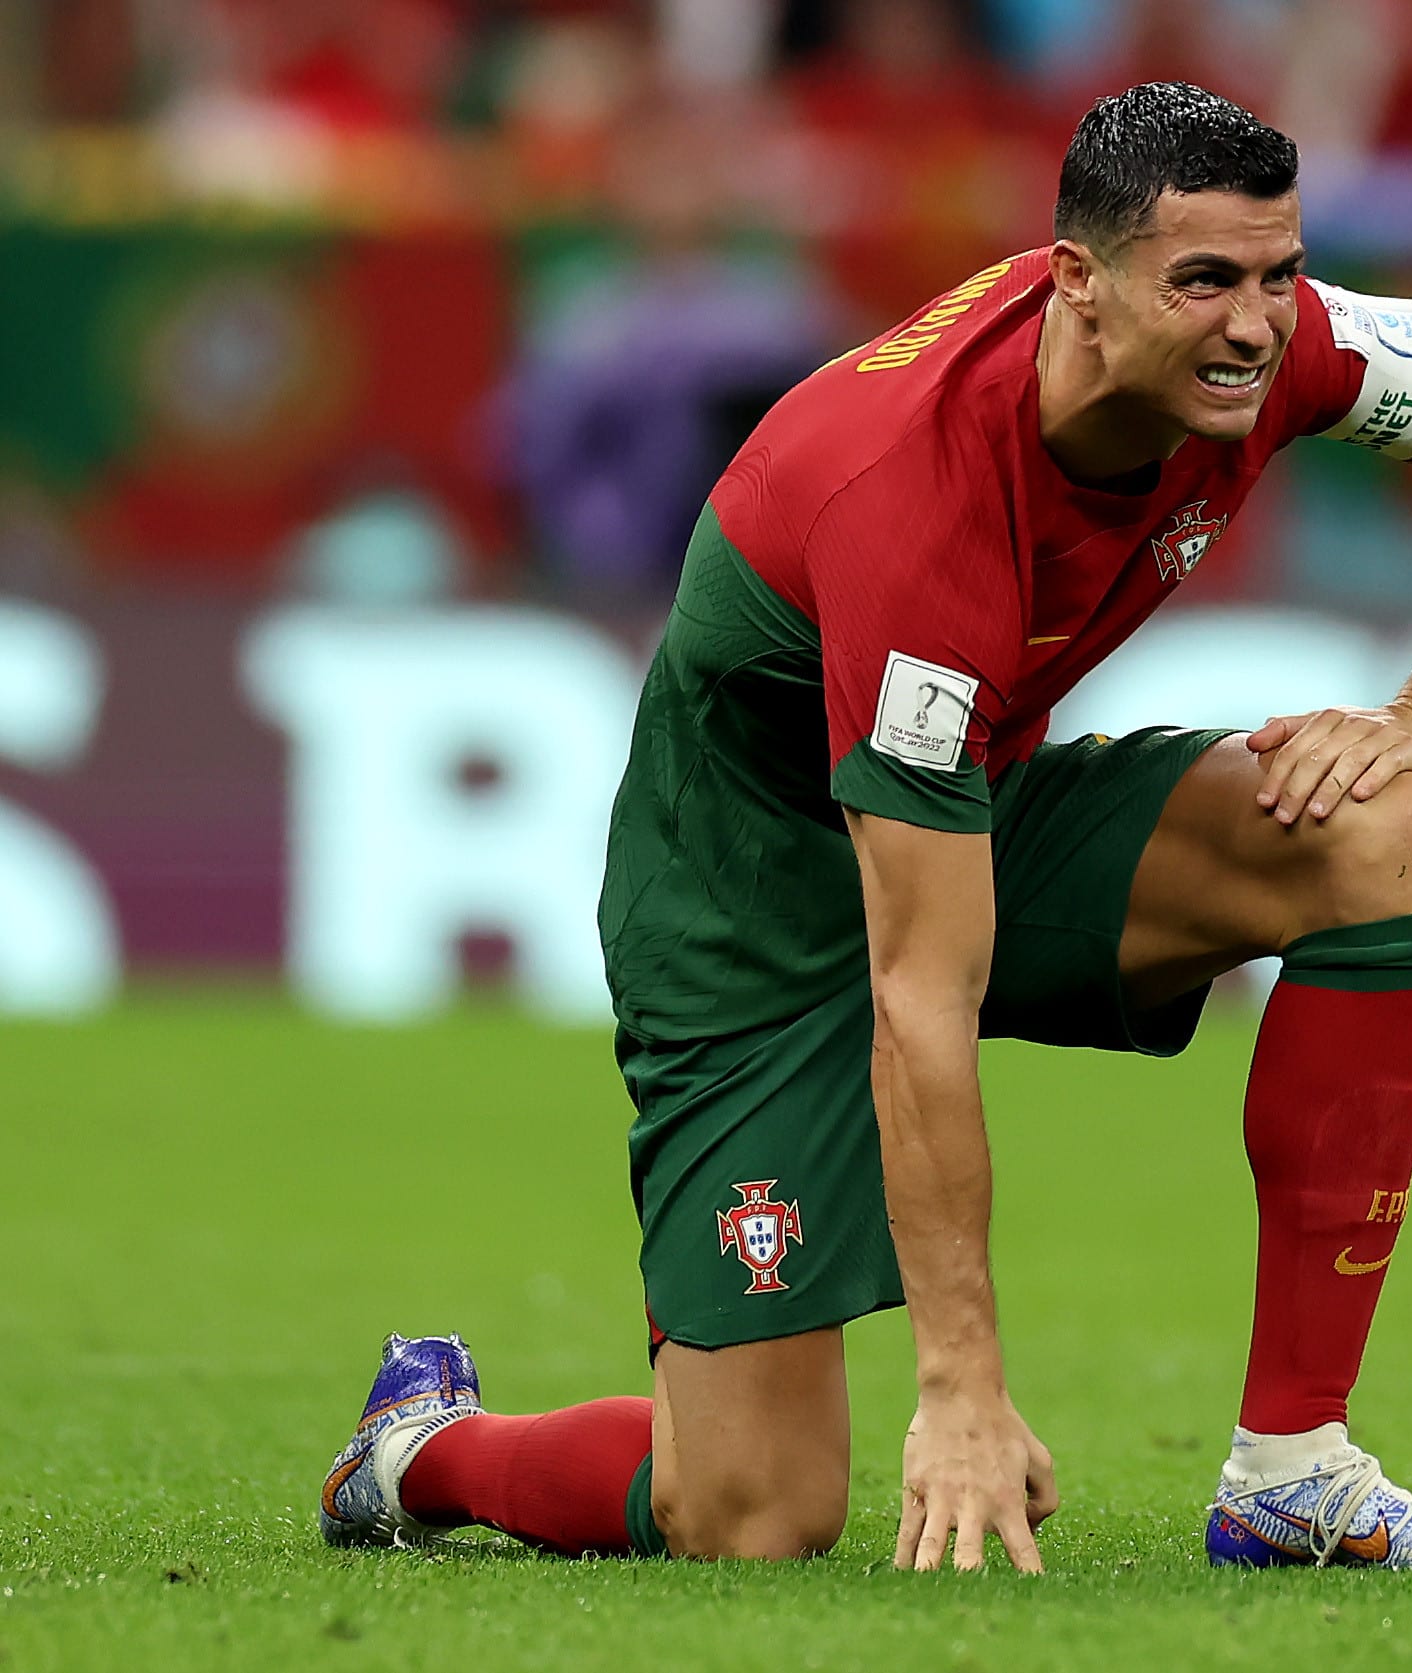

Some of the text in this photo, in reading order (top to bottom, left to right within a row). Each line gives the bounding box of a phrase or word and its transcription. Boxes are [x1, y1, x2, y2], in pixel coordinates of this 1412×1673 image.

[856, 249, 1037, 373] ONALDO
[1355, 389, 1399, 436] THE
[888, 724, 946, 745] FIFA WORLD CUP
